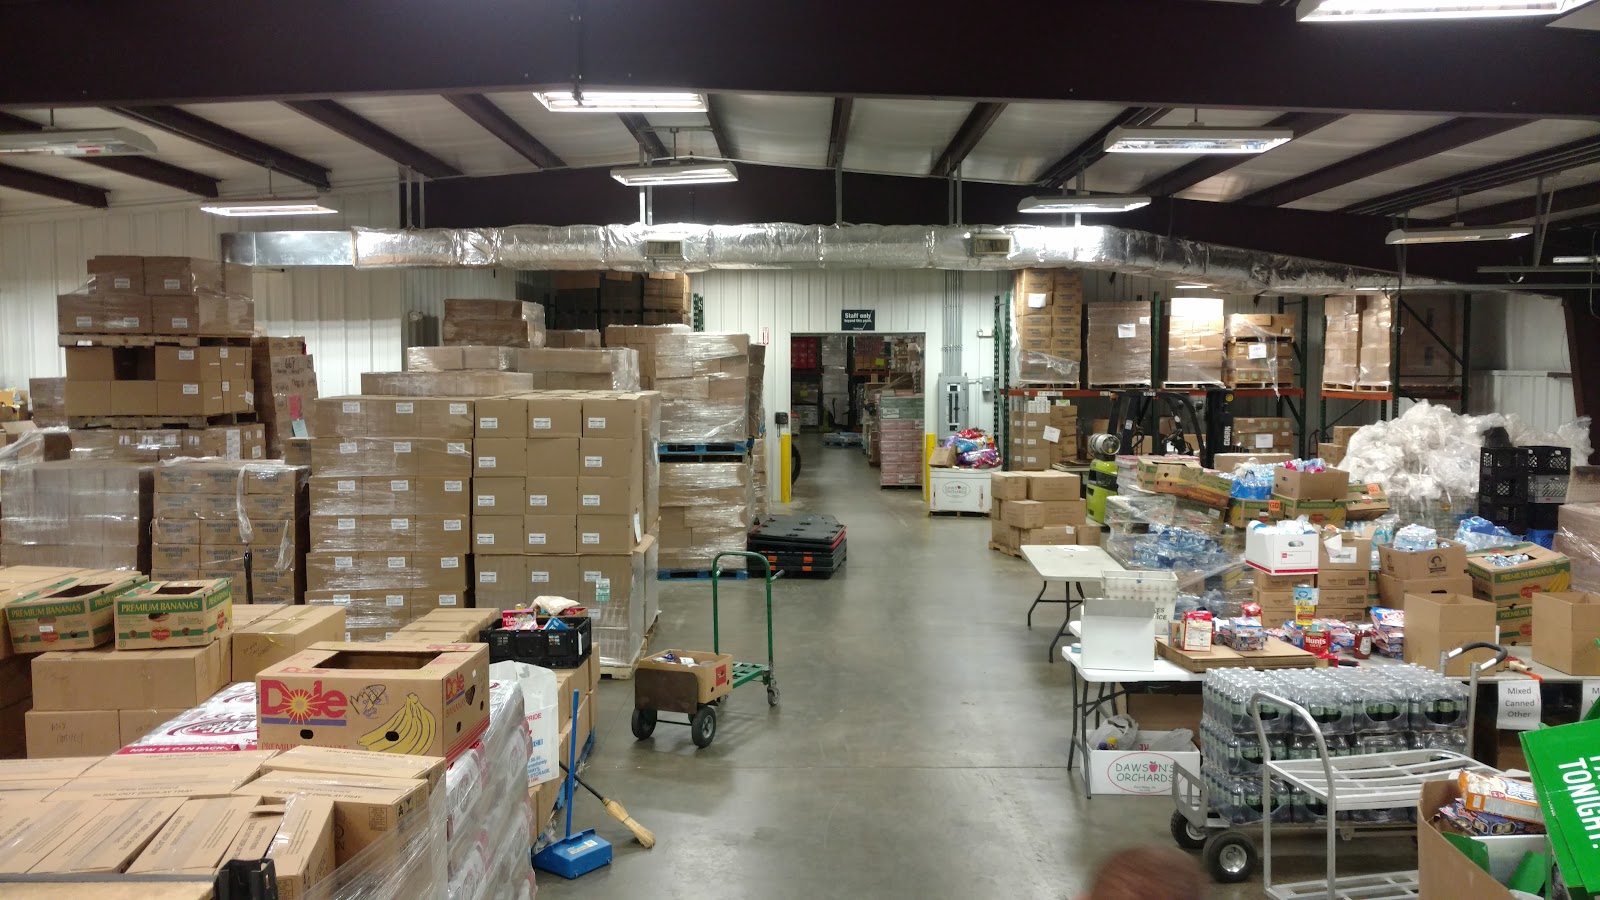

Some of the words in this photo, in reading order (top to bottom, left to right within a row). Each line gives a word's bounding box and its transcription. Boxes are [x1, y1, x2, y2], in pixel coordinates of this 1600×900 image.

[1501, 572, 1528, 581] PREMIUM
[11, 608, 45, 618] PREMIUM
[46, 604, 81, 615] BANANAS
[121, 603, 158, 612] PREMIUM
[160, 601, 198, 611] BANANAS
[1501, 608, 1528, 618] PREMIUM
[446, 672, 465, 700] Dole
[261, 680, 348, 720] Dole
[1117, 773, 1174, 782] ORCHARDS
